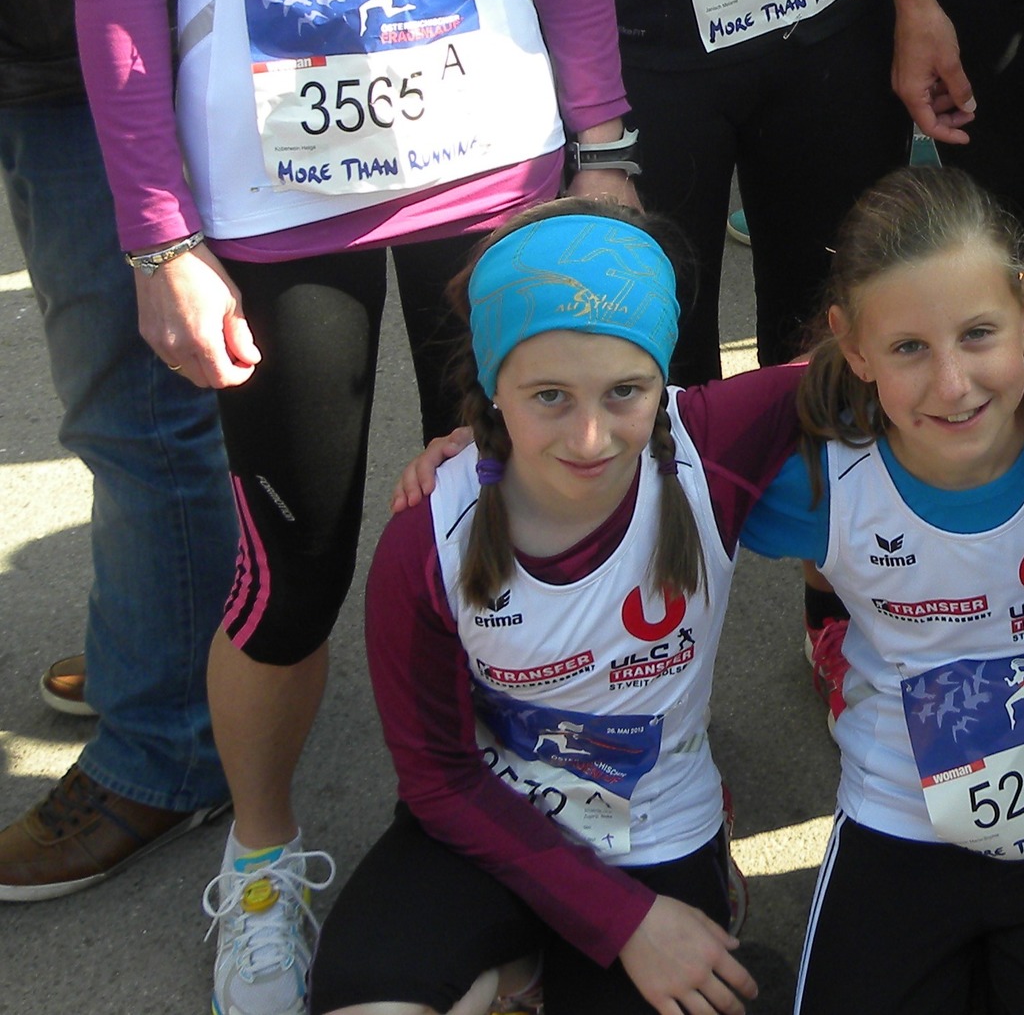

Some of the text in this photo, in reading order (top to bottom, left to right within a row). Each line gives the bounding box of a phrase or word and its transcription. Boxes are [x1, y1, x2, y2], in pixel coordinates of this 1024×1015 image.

[710, 12, 755, 43] MORE
[442, 44, 465, 80] A
[300, 71, 425, 135] 3565
[278, 159, 332, 185] MORE
[341, 158, 399, 182] THAN
[870, 553, 917, 567] erima
[474, 613, 523, 628] erima
[892, 599, 984, 615] TRANSFER
[493, 654, 592, 681] TRANSFER
[610, 643, 669, 669] ULC
[613, 650, 692, 681] TRANSFER
[932, 763, 973, 784] woman
